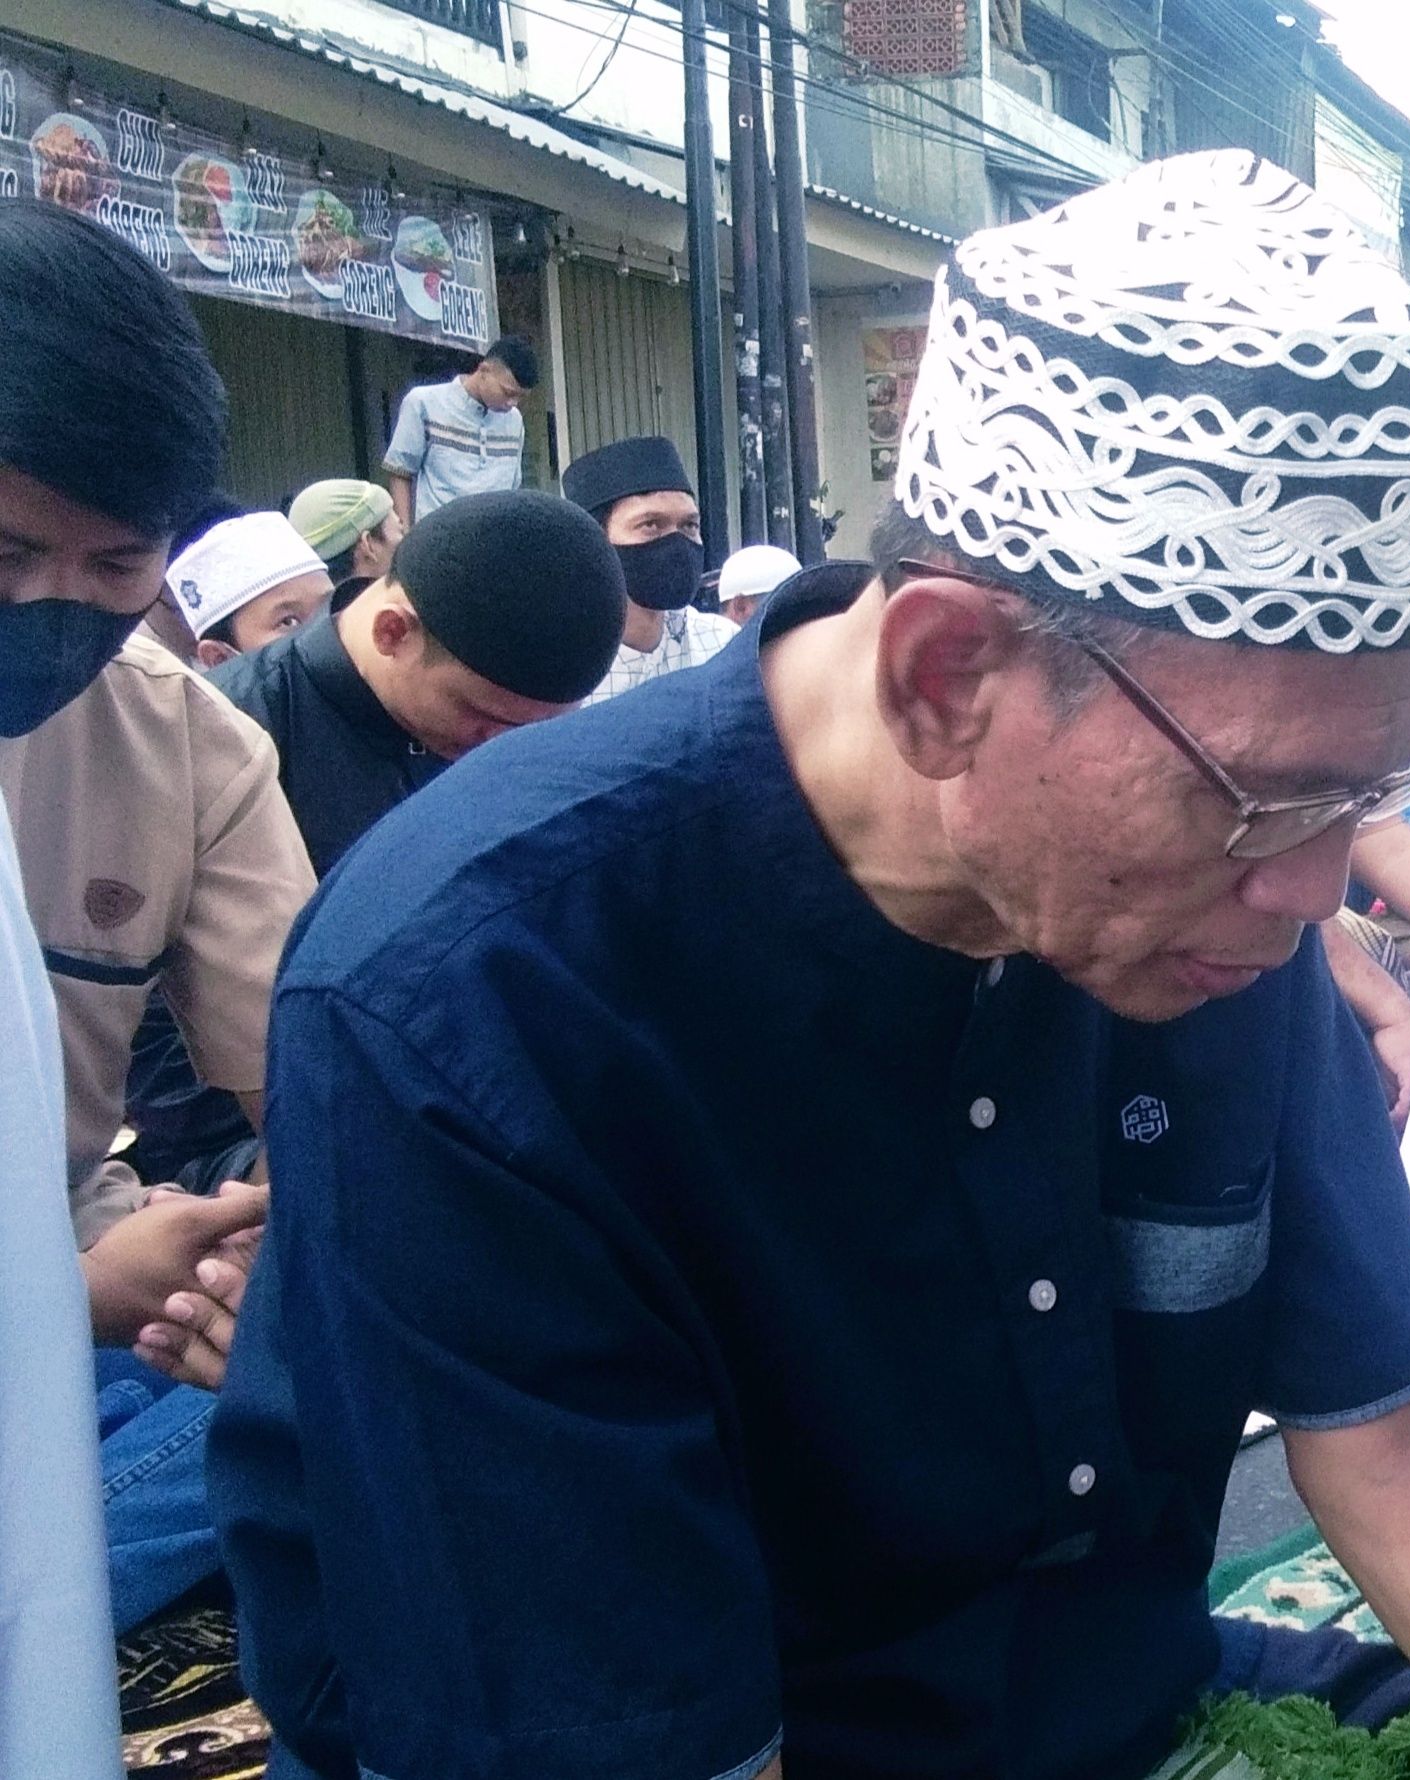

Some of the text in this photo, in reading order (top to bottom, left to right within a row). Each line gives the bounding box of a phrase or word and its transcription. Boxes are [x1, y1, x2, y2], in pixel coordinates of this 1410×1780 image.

[229, 229, 291, 299] GORENG
[339, 258, 396, 322] GORENG
[439, 279, 488, 342] GORENG
